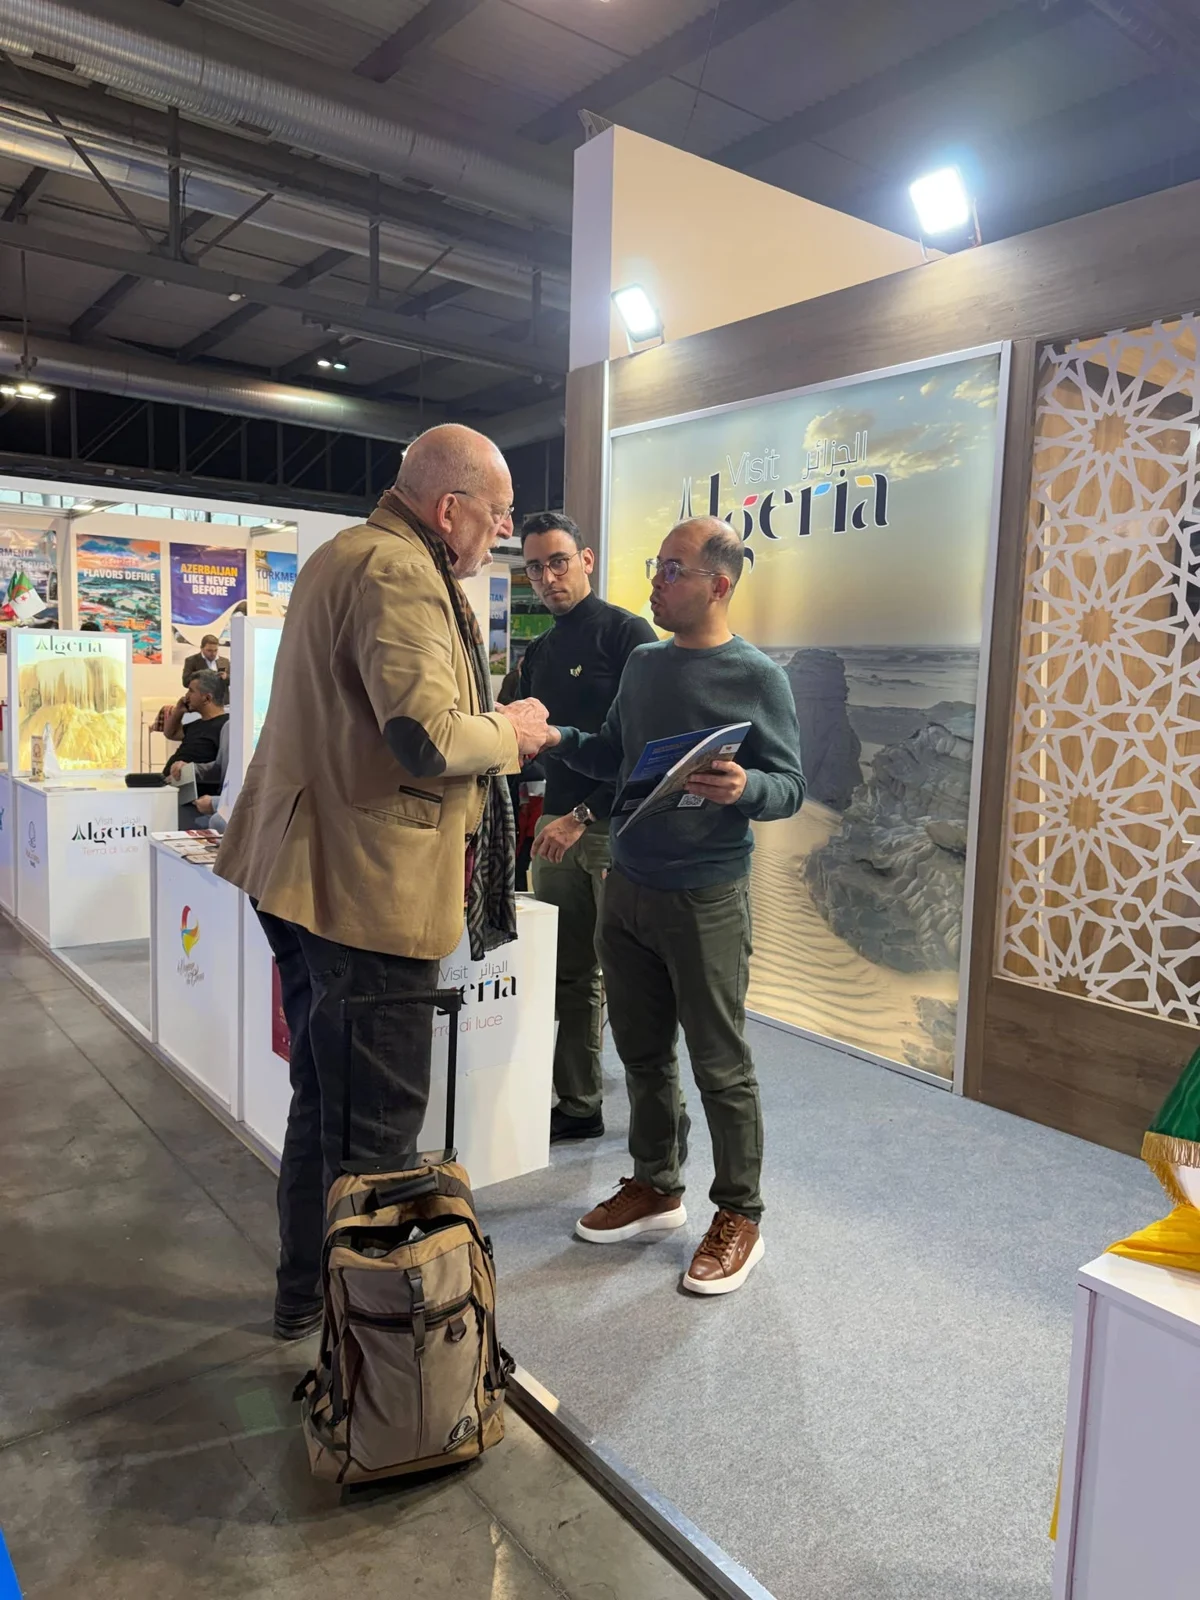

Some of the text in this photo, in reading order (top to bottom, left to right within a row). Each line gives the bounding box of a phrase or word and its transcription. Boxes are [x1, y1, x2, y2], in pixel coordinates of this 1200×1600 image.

[801, 430, 868, 480] الجزائر
[726, 447, 780, 486] Visit
[83, 568, 156, 582] FLAVORS DEFINE
[181, 563, 238, 577] AZERBAIJAN
[183, 573, 236, 587] LIKE NEVER
[192, 585, 228, 596] BEFORE
[36, 635, 102, 655] Algeria
[94, 816, 113, 825] Visit
[71, 821, 147, 845] Algeria
[439, 965, 469, 981] Visit
[479, 960, 508, 979] الجزائر
[459, 1016, 472, 1033] di
[475, 1014, 504, 1030] luce
